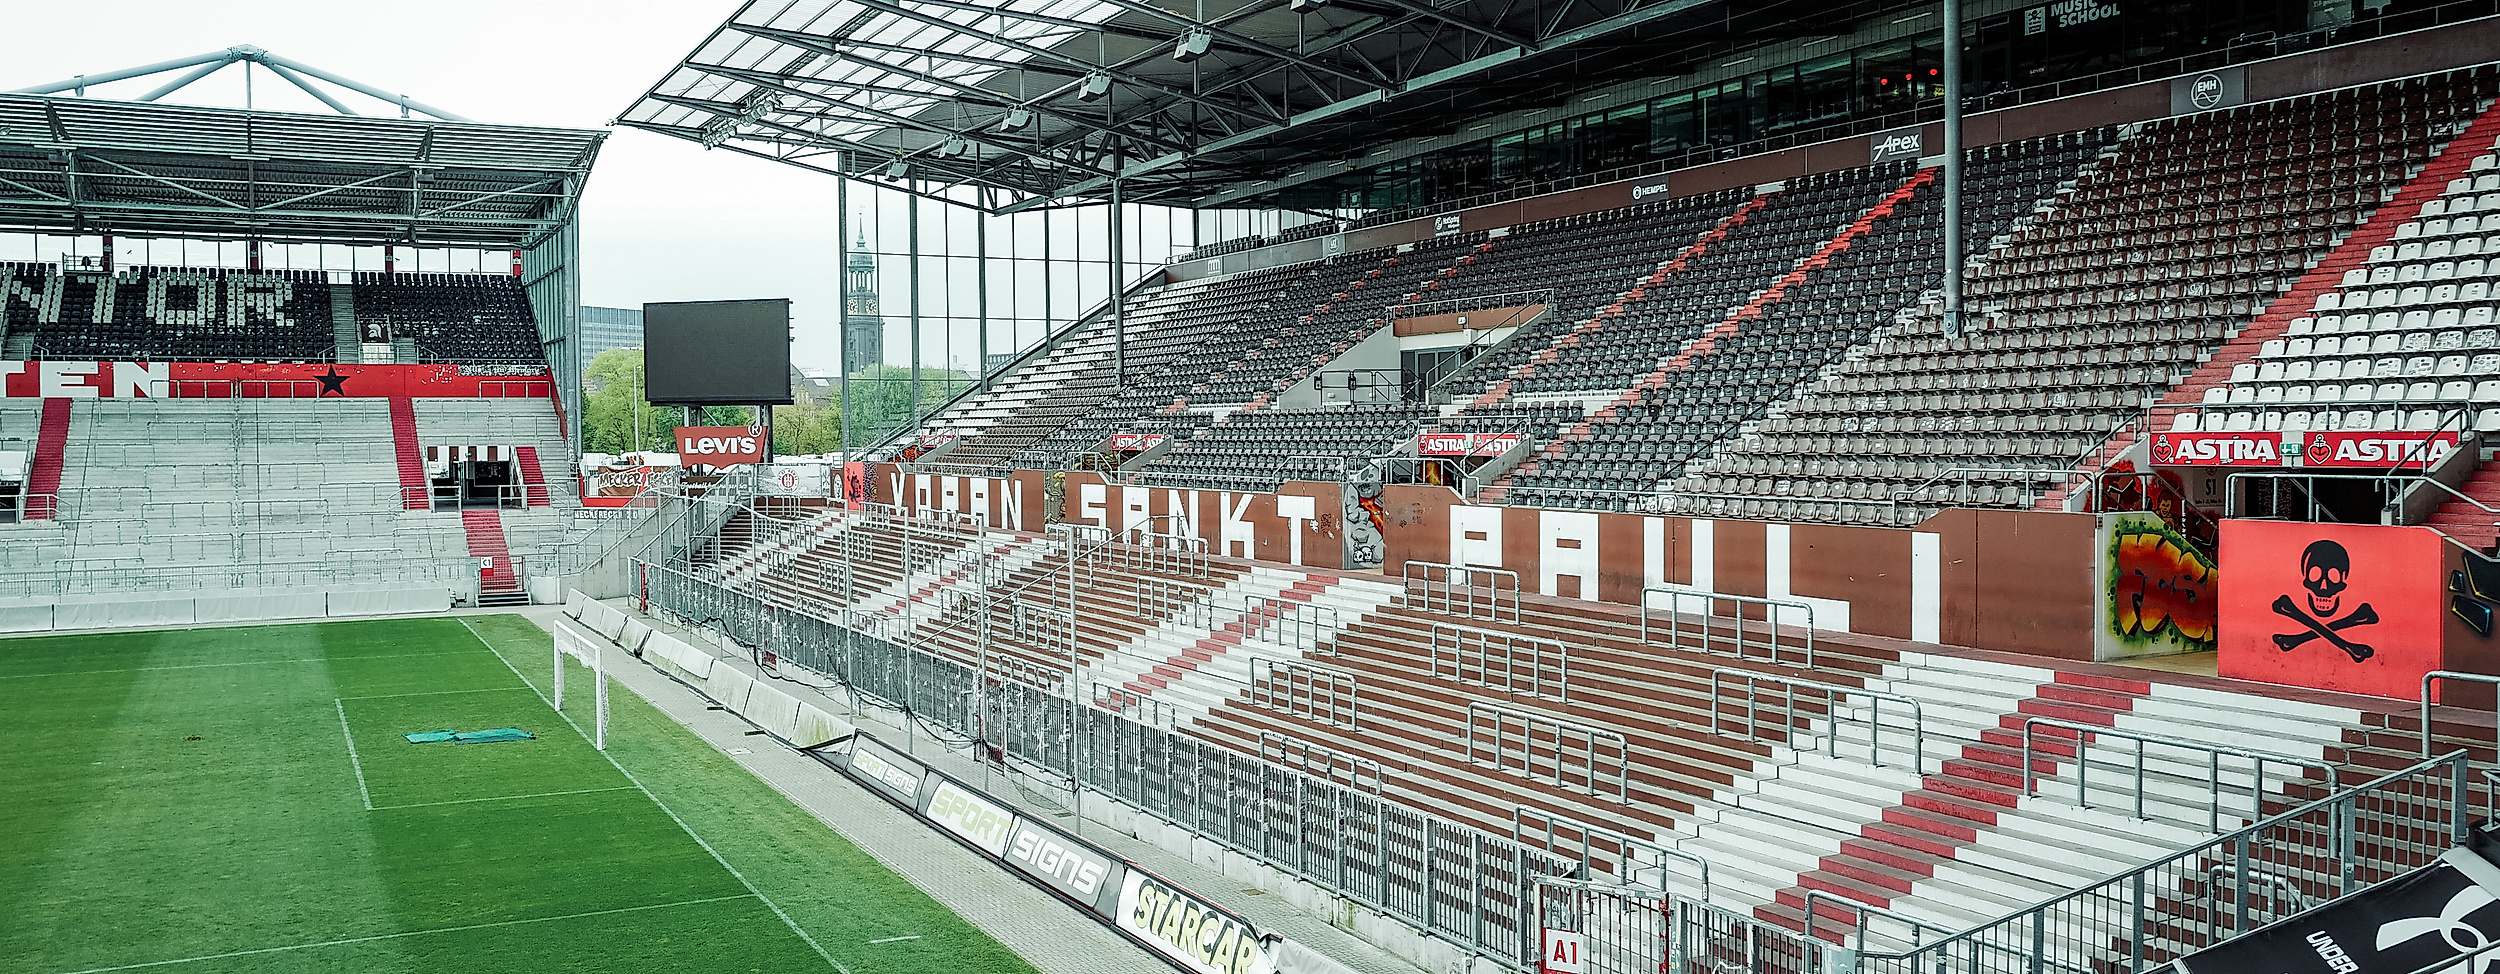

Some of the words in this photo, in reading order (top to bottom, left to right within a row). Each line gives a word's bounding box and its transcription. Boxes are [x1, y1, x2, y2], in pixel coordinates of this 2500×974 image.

[2059, 3, 2121, 28] SCHOOL
[2197, 79, 2217, 93] EMH
[1642, 183, 1669, 196] HEMPEL
[1427, 438, 1465, 452] ASTRA
[1483, 438, 1521, 452] ASTR
[2174, 438, 2278, 461] ASTRA
[2334, 439, 2452, 462] ASTRA
[599, 472, 642, 486] MECKER
[2205, 478, 2217, 496] S1
[1080, 484, 1316, 567] SANKT
[1449, 504, 1941, 645] PAULI
[854, 750, 887, 782] SPORT
[884, 767, 917, 798] SIGNS
[931, 788, 1015, 846] SPORT
[1011, 828, 1104, 896] SIGNS
[1133, 878, 1258, 974] STARCAR
[1553, 939, 1577, 965] A1
[2305, 930, 2360, 974] UNDER
